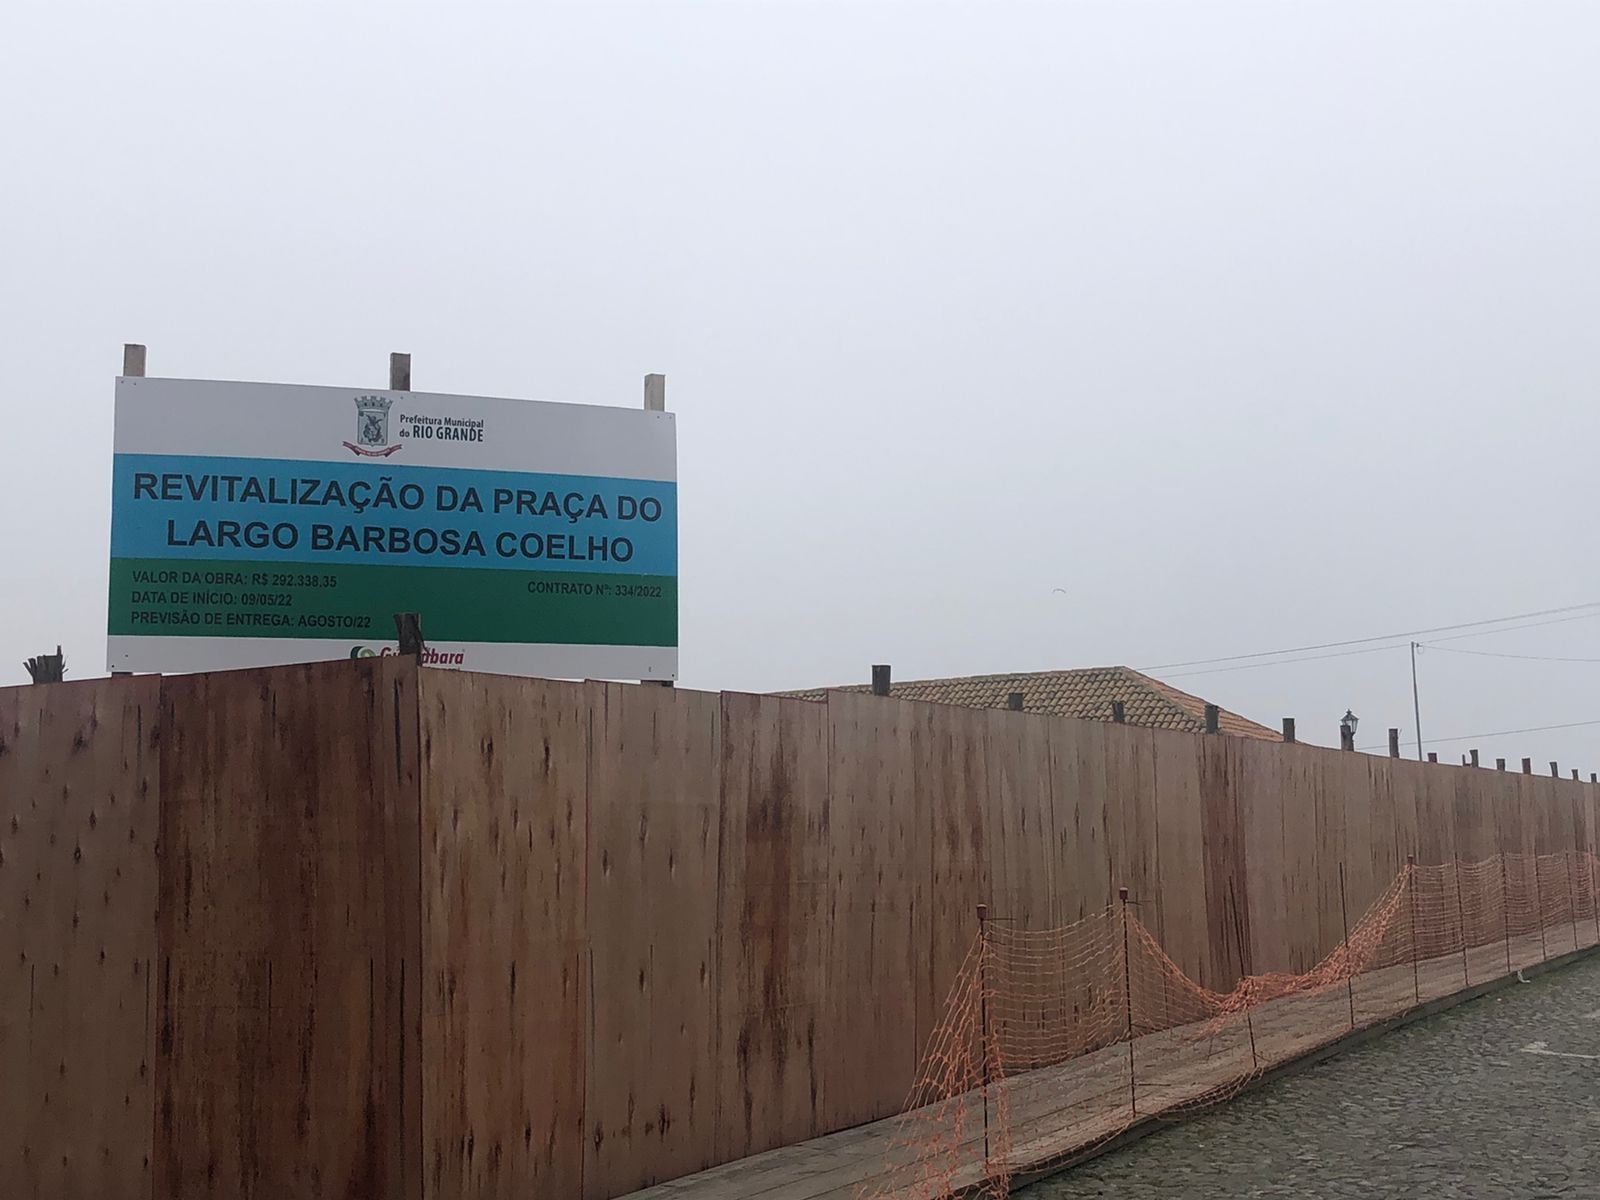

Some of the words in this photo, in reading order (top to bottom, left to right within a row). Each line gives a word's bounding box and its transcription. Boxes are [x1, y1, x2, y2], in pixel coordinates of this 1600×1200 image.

[400, 414, 442, 425] Prefeitura
[444, 417, 484, 428] Municipal
[399, 428, 410, 438] do
[413, 425, 433, 439] RIO
[436, 427, 484, 442] GRANDE
[134, 473, 424, 513] REVITALIZAÇÃO
[436, 485, 484, 513] DA
[493, 488, 608, 524] PRAÇA
[617, 495, 662, 522] DO
[167, 519, 298, 549] LARGO
[311, 524, 486, 556] BARBOSA
[496, 532, 633, 562] COELHO
[133, 571, 178, 584] VALOR
[182, 572, 201, 584] DA
[205, 572, 248, 585] OBRA:
[252, 574, 268, 586] R$
[272, 574, 337, 588] 292.338.35
[132, 591, 167, 604] DATA
[170, 592, 189, 604] DE
[193, 589, 238, 605] INÍCIO:
[241, 594, 293, 606] 09/05/22
[528, 581, 593, 596] CONTRATO
[615, 585, 662, 598] 334/2022
[131, 610, 201, 625] PREVISÃO
[205, 613, 222, 625] DE
[227, 613, 294, 627] ENTREGA:
[298, 615, 371, 628] AGOSTO/22
